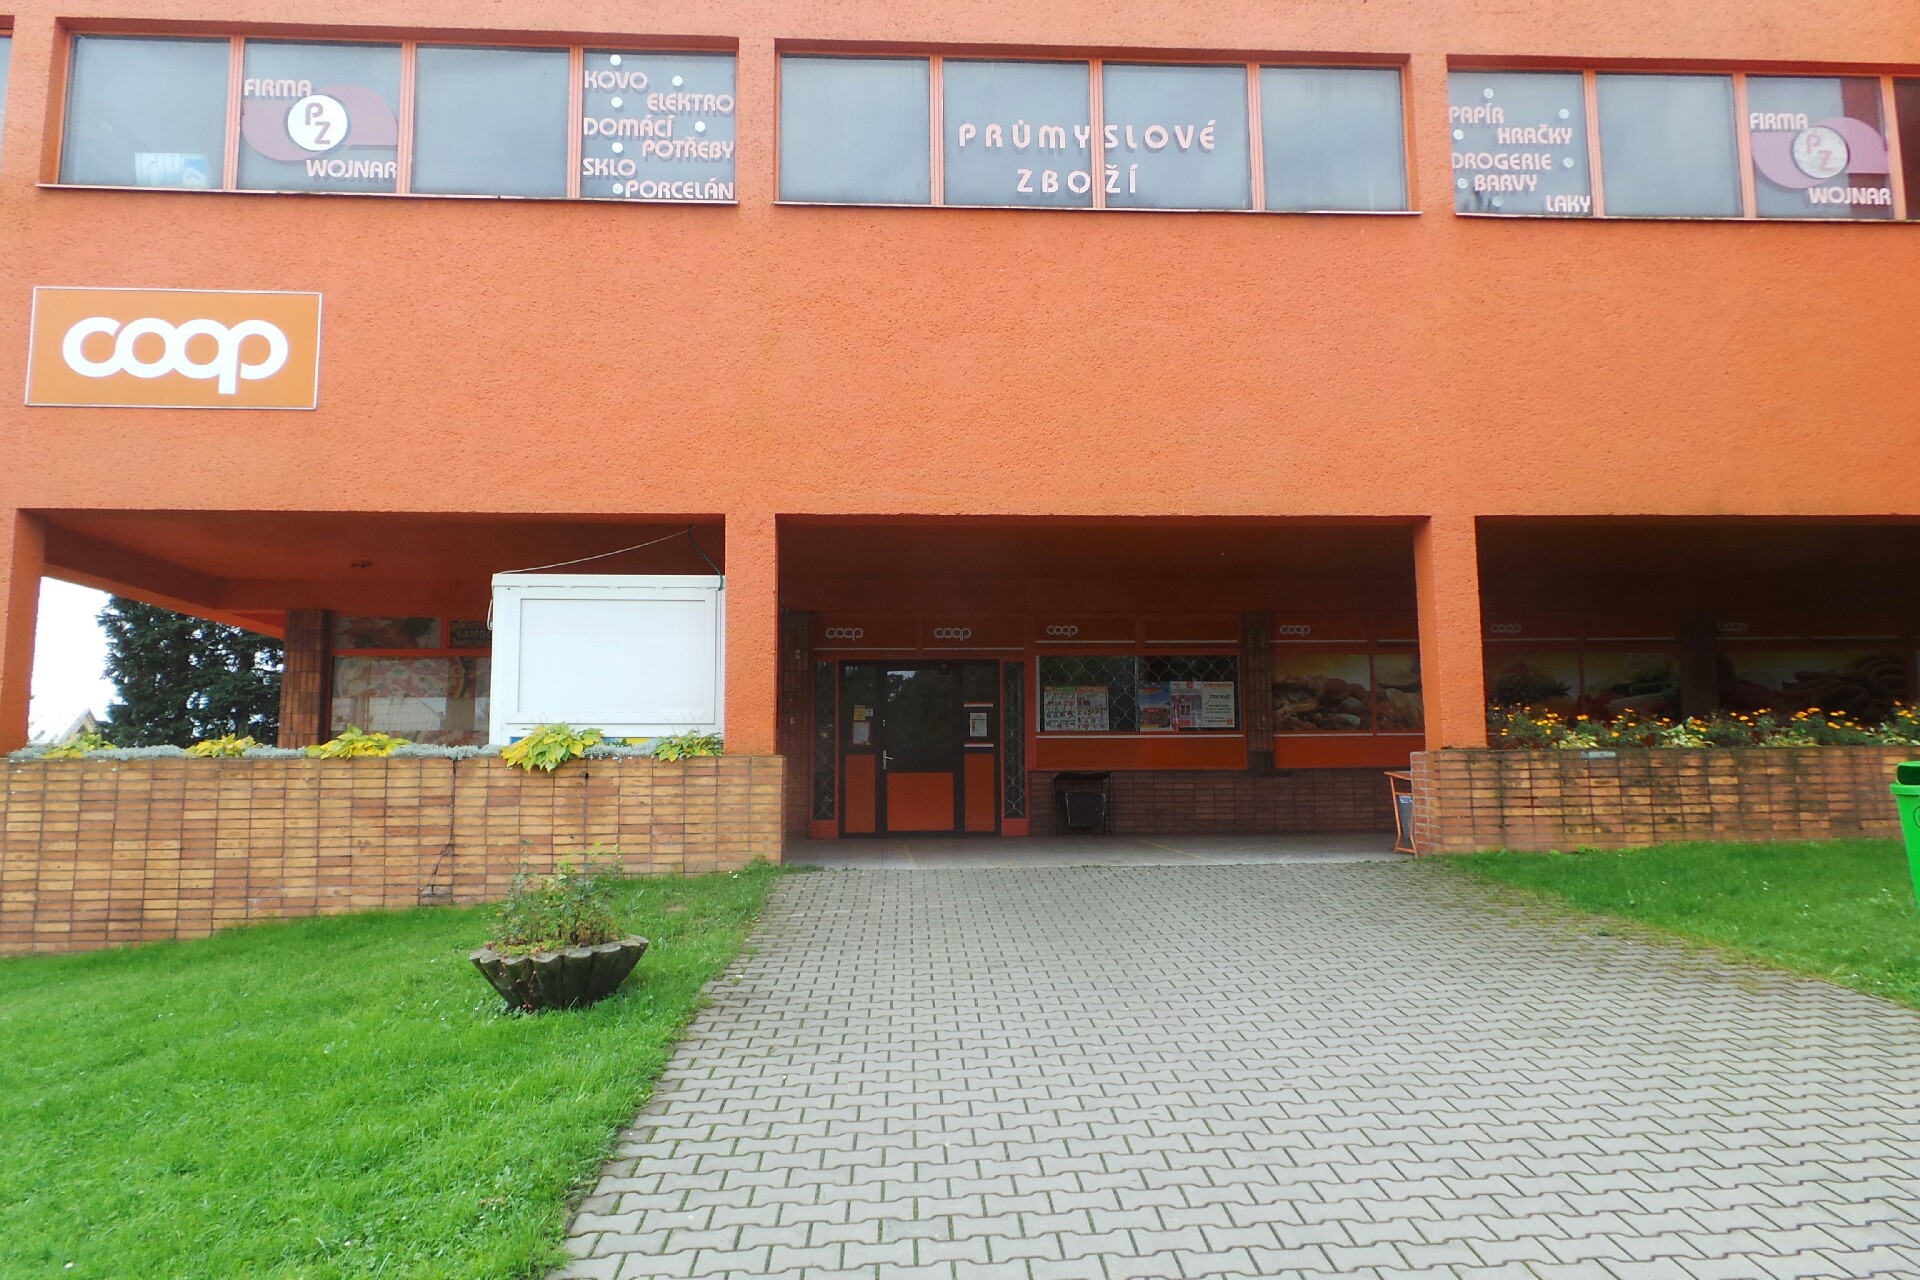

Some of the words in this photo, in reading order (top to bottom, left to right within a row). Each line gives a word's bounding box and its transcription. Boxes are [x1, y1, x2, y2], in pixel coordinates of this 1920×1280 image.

[244, 78, 312, 97] FIRMA
[584, 70, 648, 89] KOVO
[646, 92, 734, 112] ELEKTRO
[1449, 103, 1504, 124] PAPÍR
[1750, 113, 1809, 130] FIRMA
[583, 115, 675, 137] DOMÁCÍ
[958, 119, 1216, 149] PRŮMYSLOVÉ
[1497, 123, 1573, 144] HRAČKY
[642, 136, 735, 159] POTŘEBY
[305, 159, 398, 178] WOJNAR
[582, 158, 637, 177] SKLO
[1452, 152, 1552, 170] DROGERIE
[1016, 164, 1139, 194] ZBOŽÍ
[1474, 174, 1538, 191] BARVY
[625, 178, 735, 200] PORCELÁN
[1807, 186, 1892, 206] WOJNAR
[1545, 195, 1591, 213] LAKY
[62, 317, 289, 395] coop
[825, 628, 864, 641] coop
[934, 628, 972, 641] coop
[1046, 625, 1079, 638] coop
[1279, 625, 1312, 637] coop
